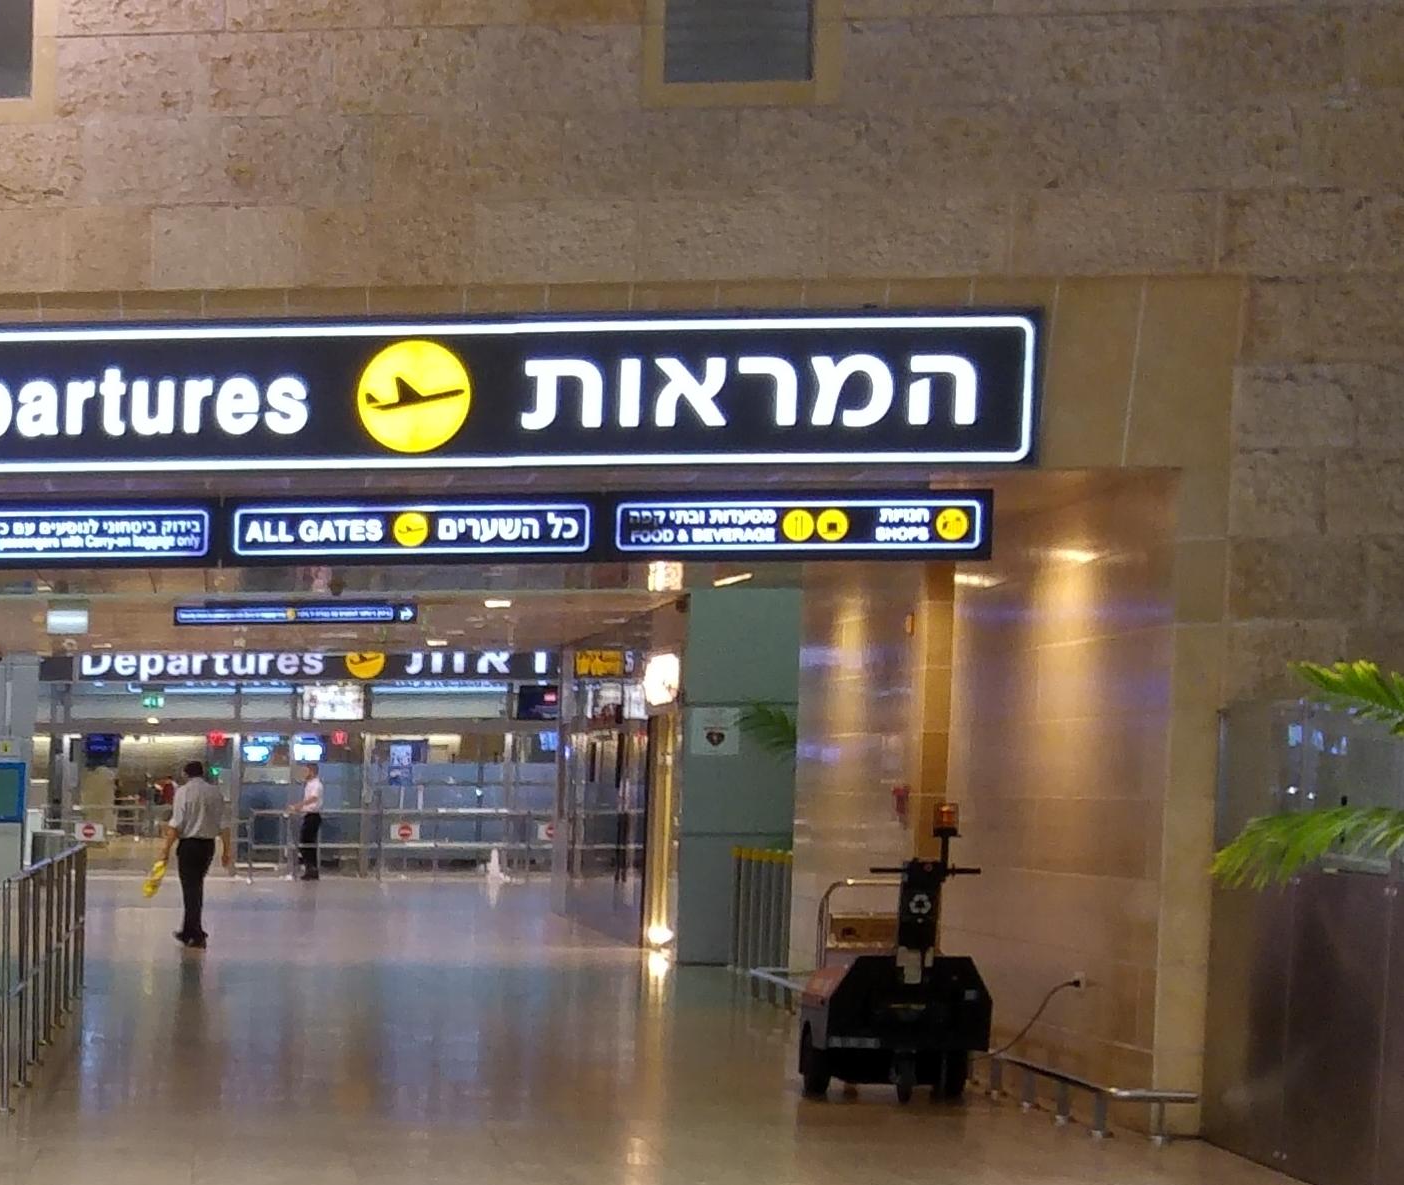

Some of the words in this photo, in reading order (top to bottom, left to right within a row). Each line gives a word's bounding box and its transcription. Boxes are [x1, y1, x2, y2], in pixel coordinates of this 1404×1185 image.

[520, 353, 978, 431] המראות
[12, 521, 37, 537] עם
[159, 519, 201, 537] בידוק
[245, 520, 294, 542] ALL
[299, 519, 384, 543] GATES
[437, 517, 541, 543] השערים
[547, 512, 579, 540] כל
[630, 529, 674, 543] FOOD
[676, 528, 689, 543] &
[692, 527, 776, 543] BEVERAGE
[874, 526, 930, 542] SHOPS
[177, 534, 201, 549] only
